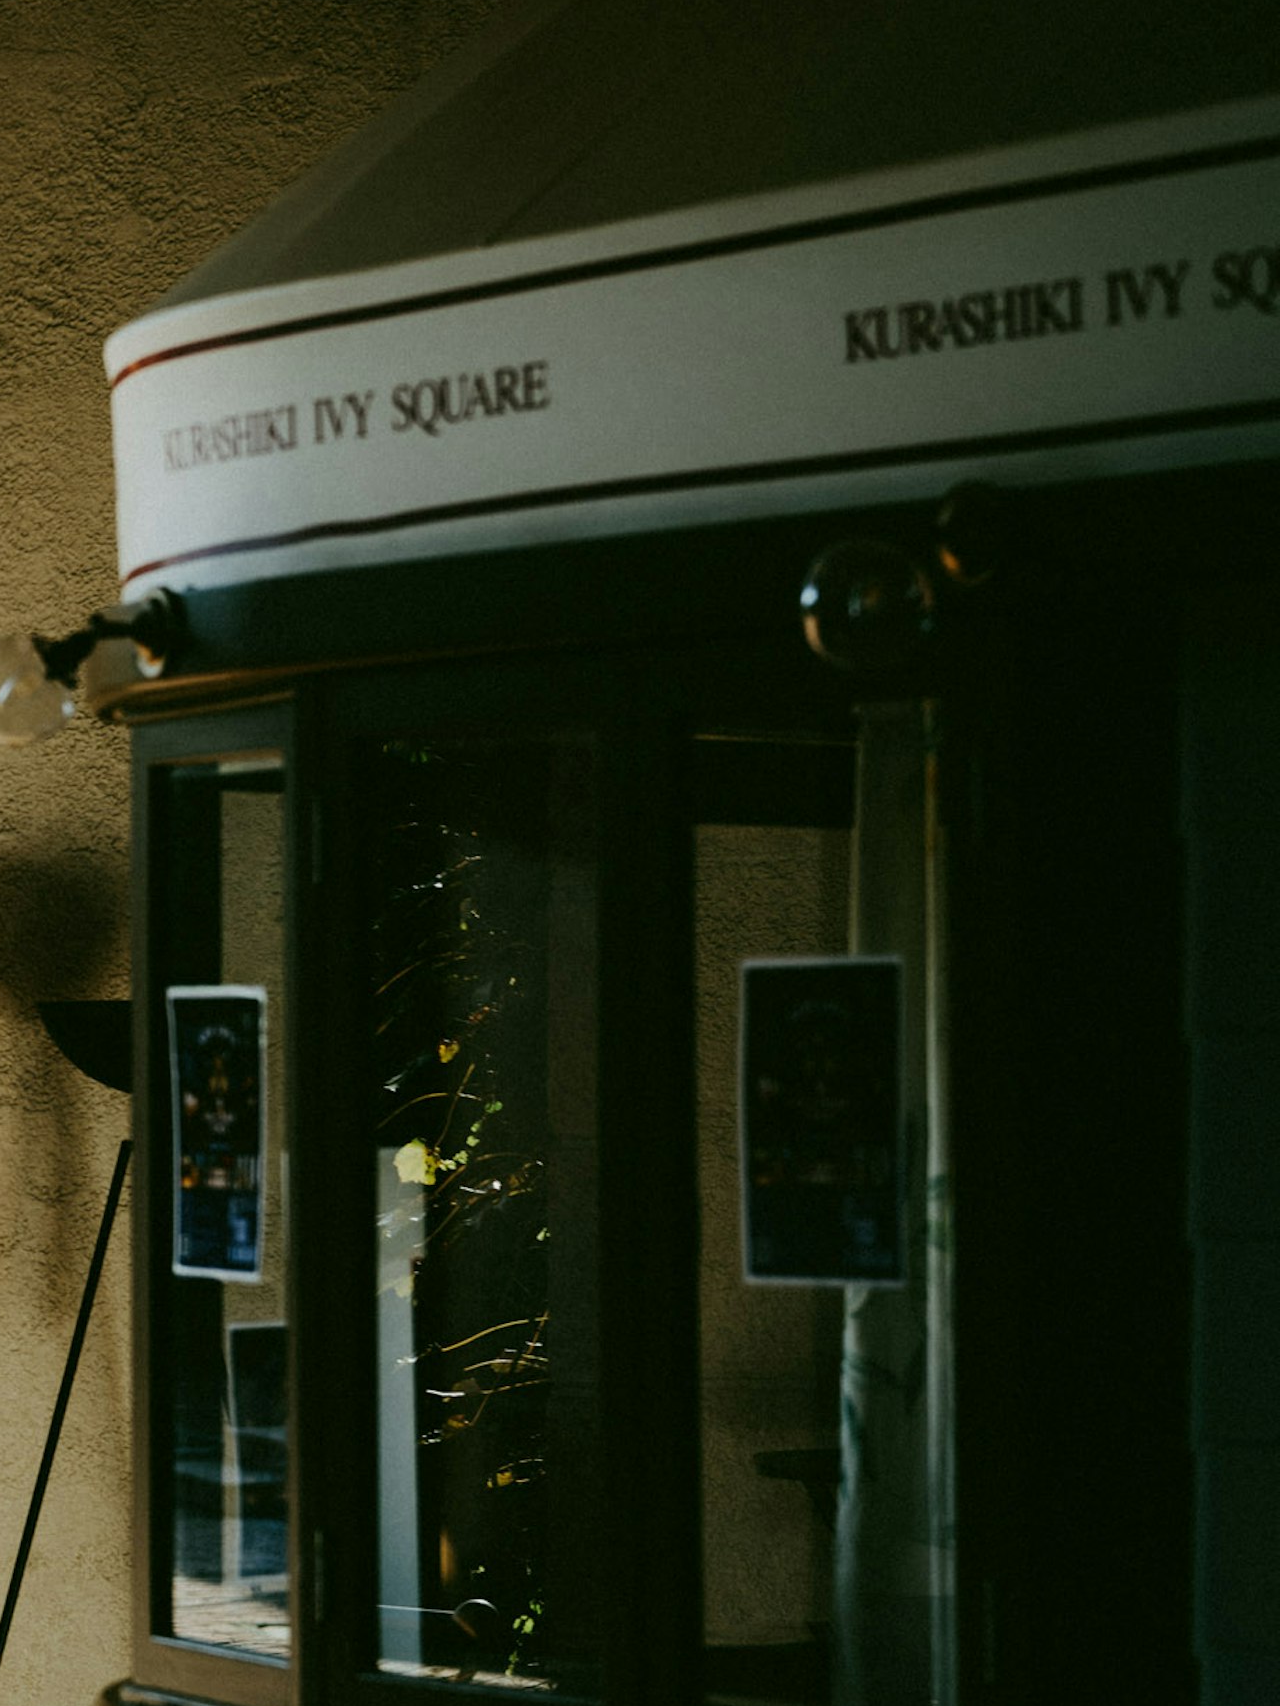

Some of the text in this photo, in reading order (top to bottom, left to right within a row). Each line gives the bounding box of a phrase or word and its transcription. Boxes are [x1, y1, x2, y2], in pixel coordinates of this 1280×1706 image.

[842, 275, 1087, 363] KURASHIKI
[1104, 258, 1191, 328] IVY
[162, 359, 553, 472] KURASHIKI IVY SQUARE
